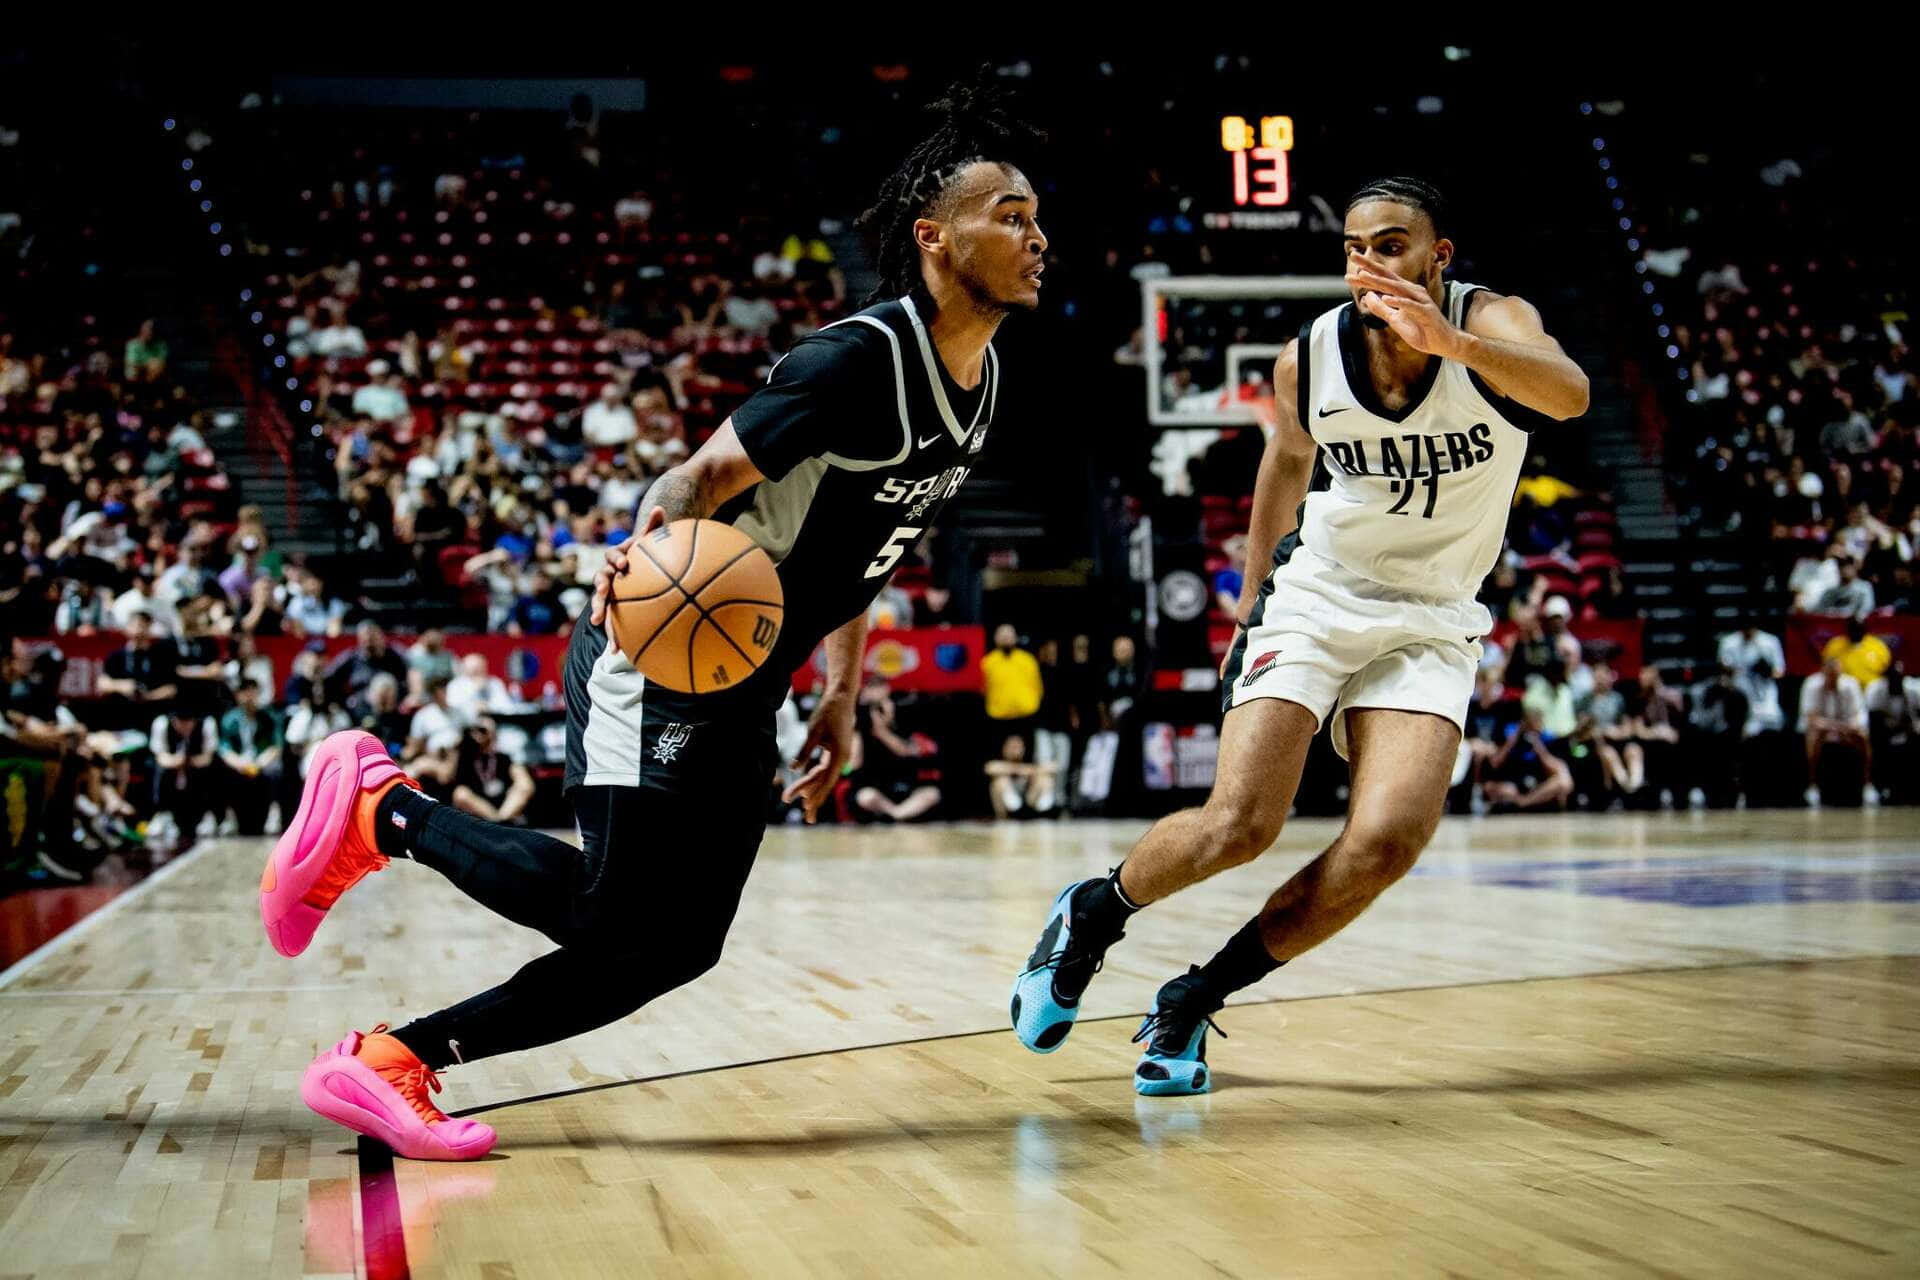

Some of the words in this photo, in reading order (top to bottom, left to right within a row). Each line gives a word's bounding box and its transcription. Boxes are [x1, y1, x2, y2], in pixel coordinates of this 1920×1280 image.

[1232, 147, 1289, 206] 13
[1325, 422, 1494, 479] BLAZERS
[873, 465, 971, 505] SPUR
[1385, 476, 1440, 519] 21
[863, 526, 923, 579] 5
